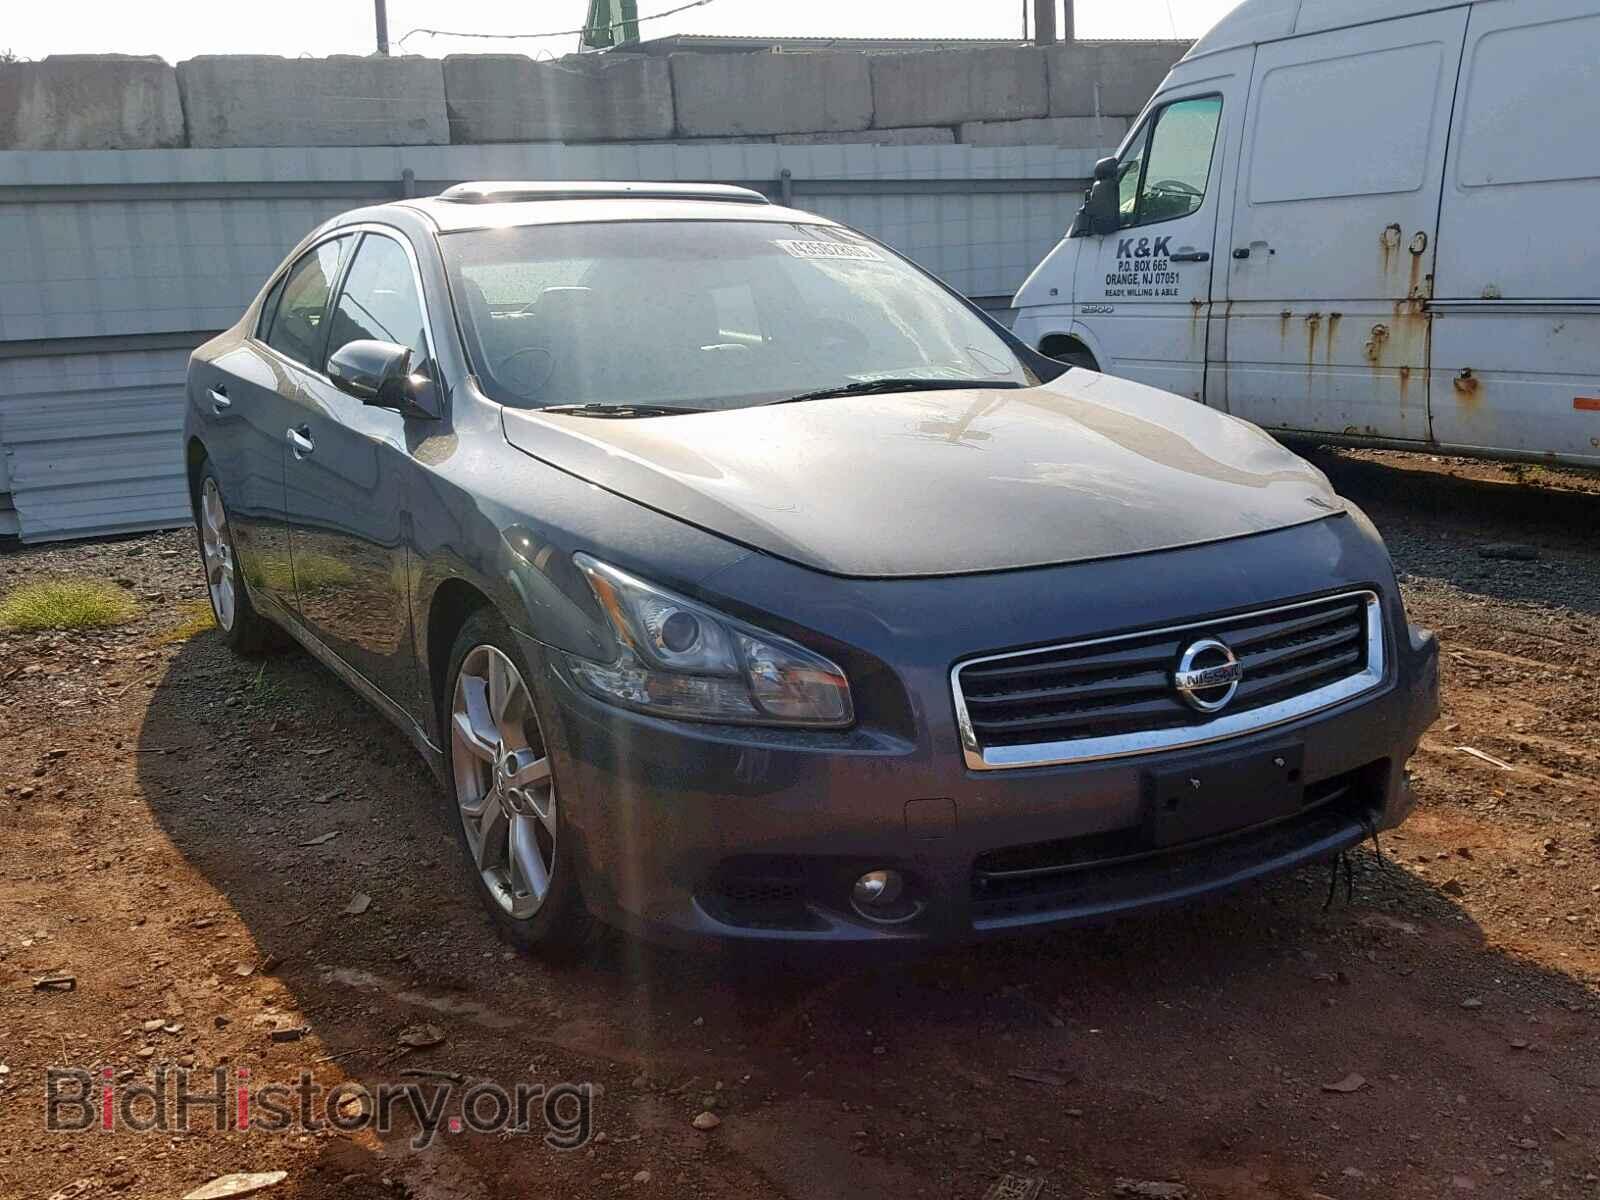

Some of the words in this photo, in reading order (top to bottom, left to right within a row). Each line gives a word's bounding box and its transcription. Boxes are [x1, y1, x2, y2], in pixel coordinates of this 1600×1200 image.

[1117, 236, 1172, 259] K&K
[1134, 260, 1151, 272] BOX
[1152, 259, 1168, 271] 665
[1105, 273, 1140, 287] ORANGE,
[1142, 272, 1154, 285] NJ
[1155, 271, 1180, 284] 07051
[1126, 288, 1153, 297] WILLING
[1161, 288, 1179, 296] ABLE
[1186, 663, 1242, 688] NISSAN
